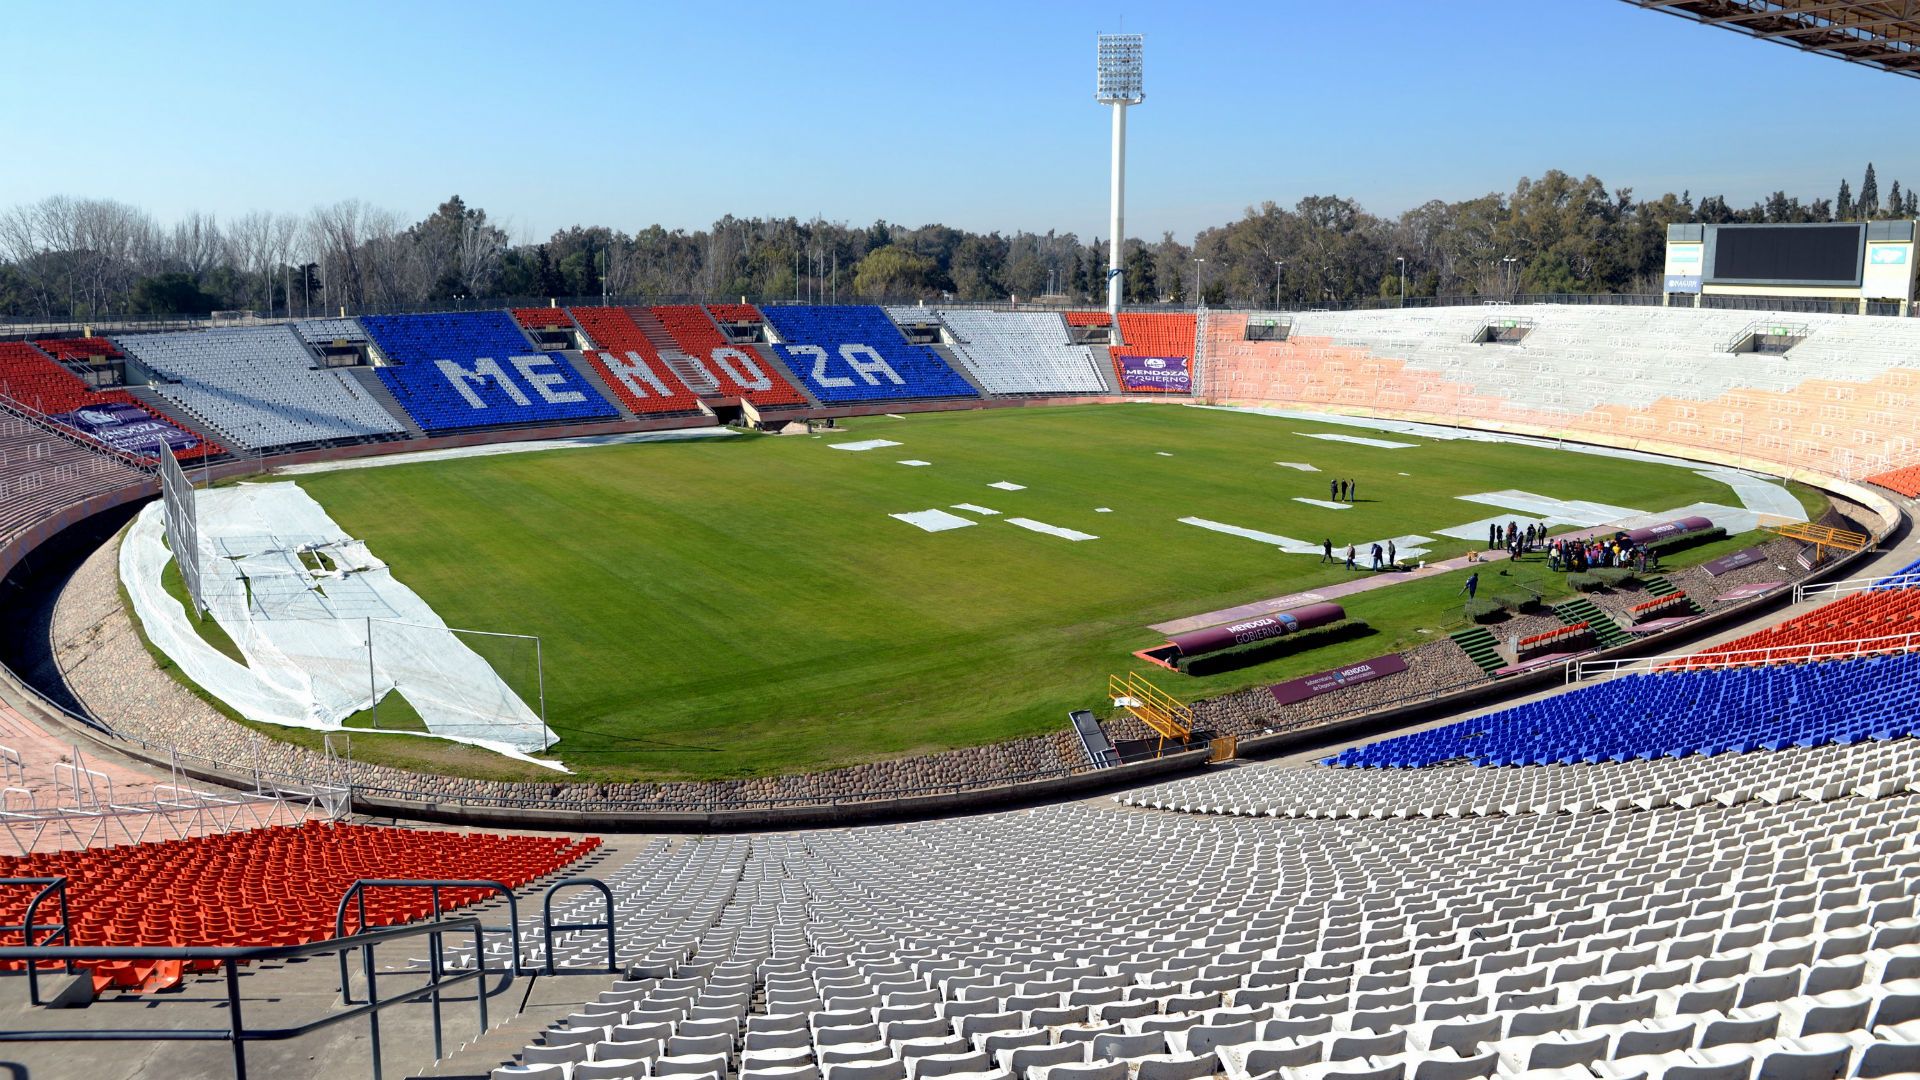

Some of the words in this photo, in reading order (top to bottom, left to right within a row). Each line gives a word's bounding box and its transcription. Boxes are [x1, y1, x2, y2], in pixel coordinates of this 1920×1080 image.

[1226, 618, 1277, 634] MENDOZA
[1235, 624, 1282, 644] GOBIERNO
[1341, 664, 1371, 677] MENDOZA
